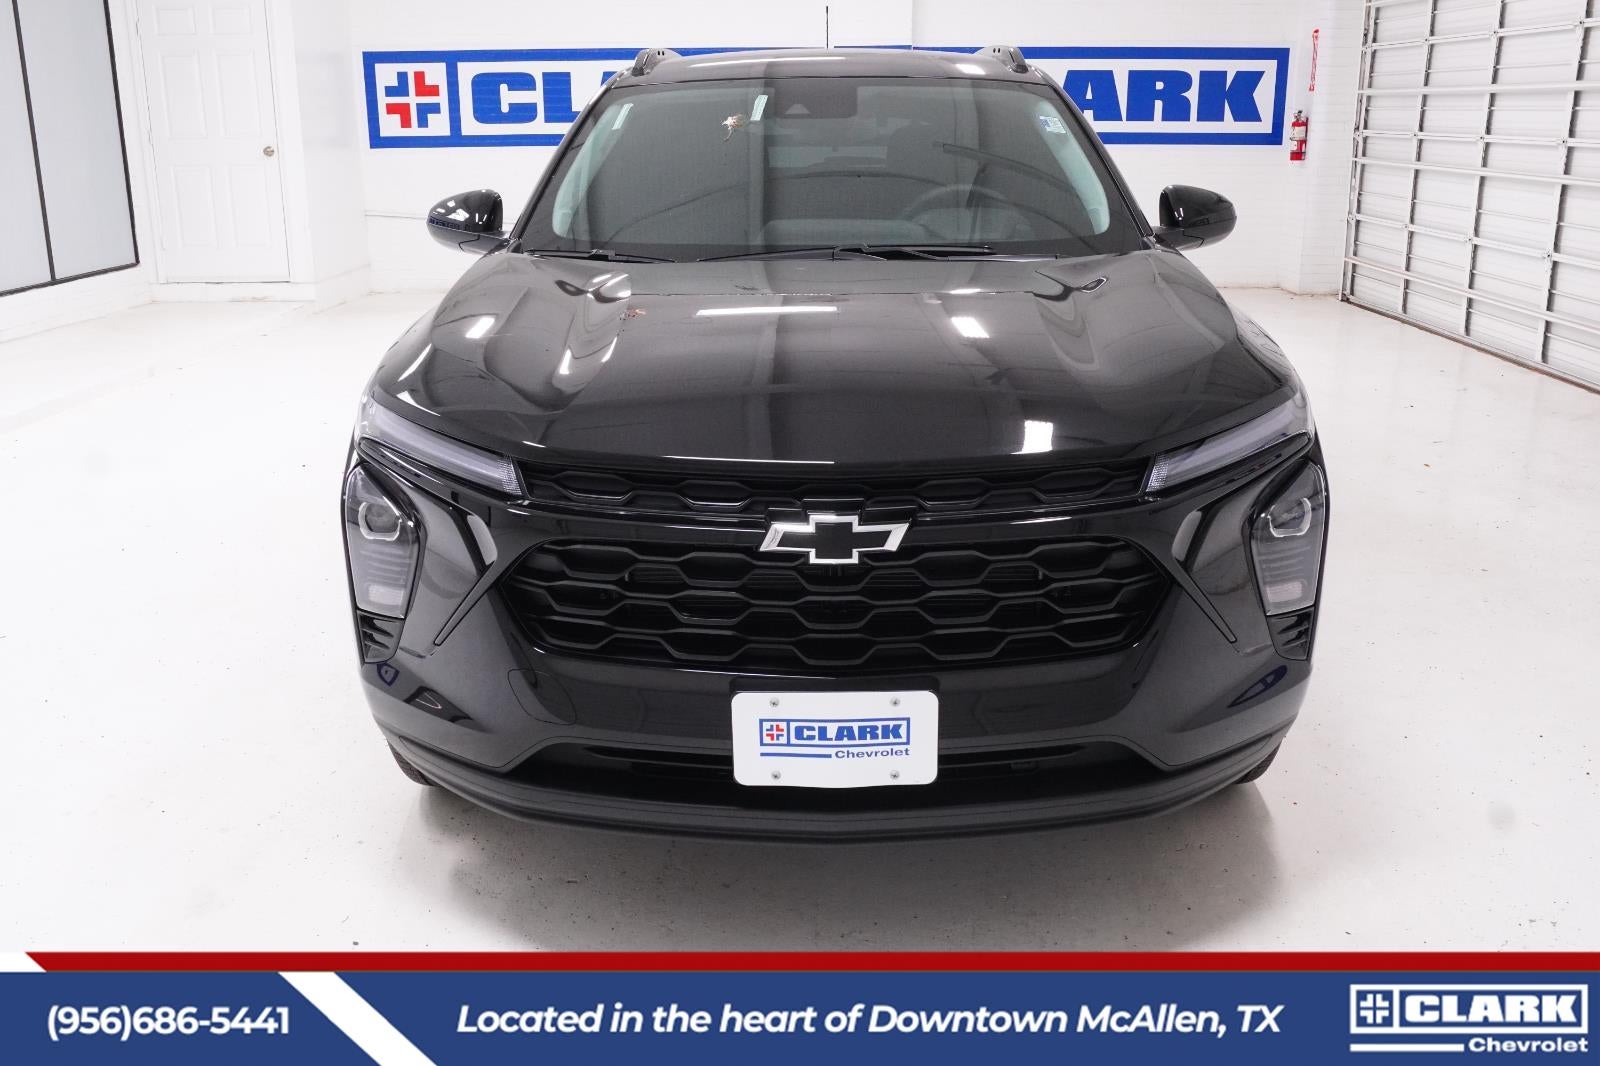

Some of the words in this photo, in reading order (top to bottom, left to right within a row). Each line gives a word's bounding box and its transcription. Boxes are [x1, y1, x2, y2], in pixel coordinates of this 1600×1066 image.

[471, 71, 616, 124] CL
[794, 723, 904, 742] CLARK
[834, 748, 910, 759] Chevrolet
